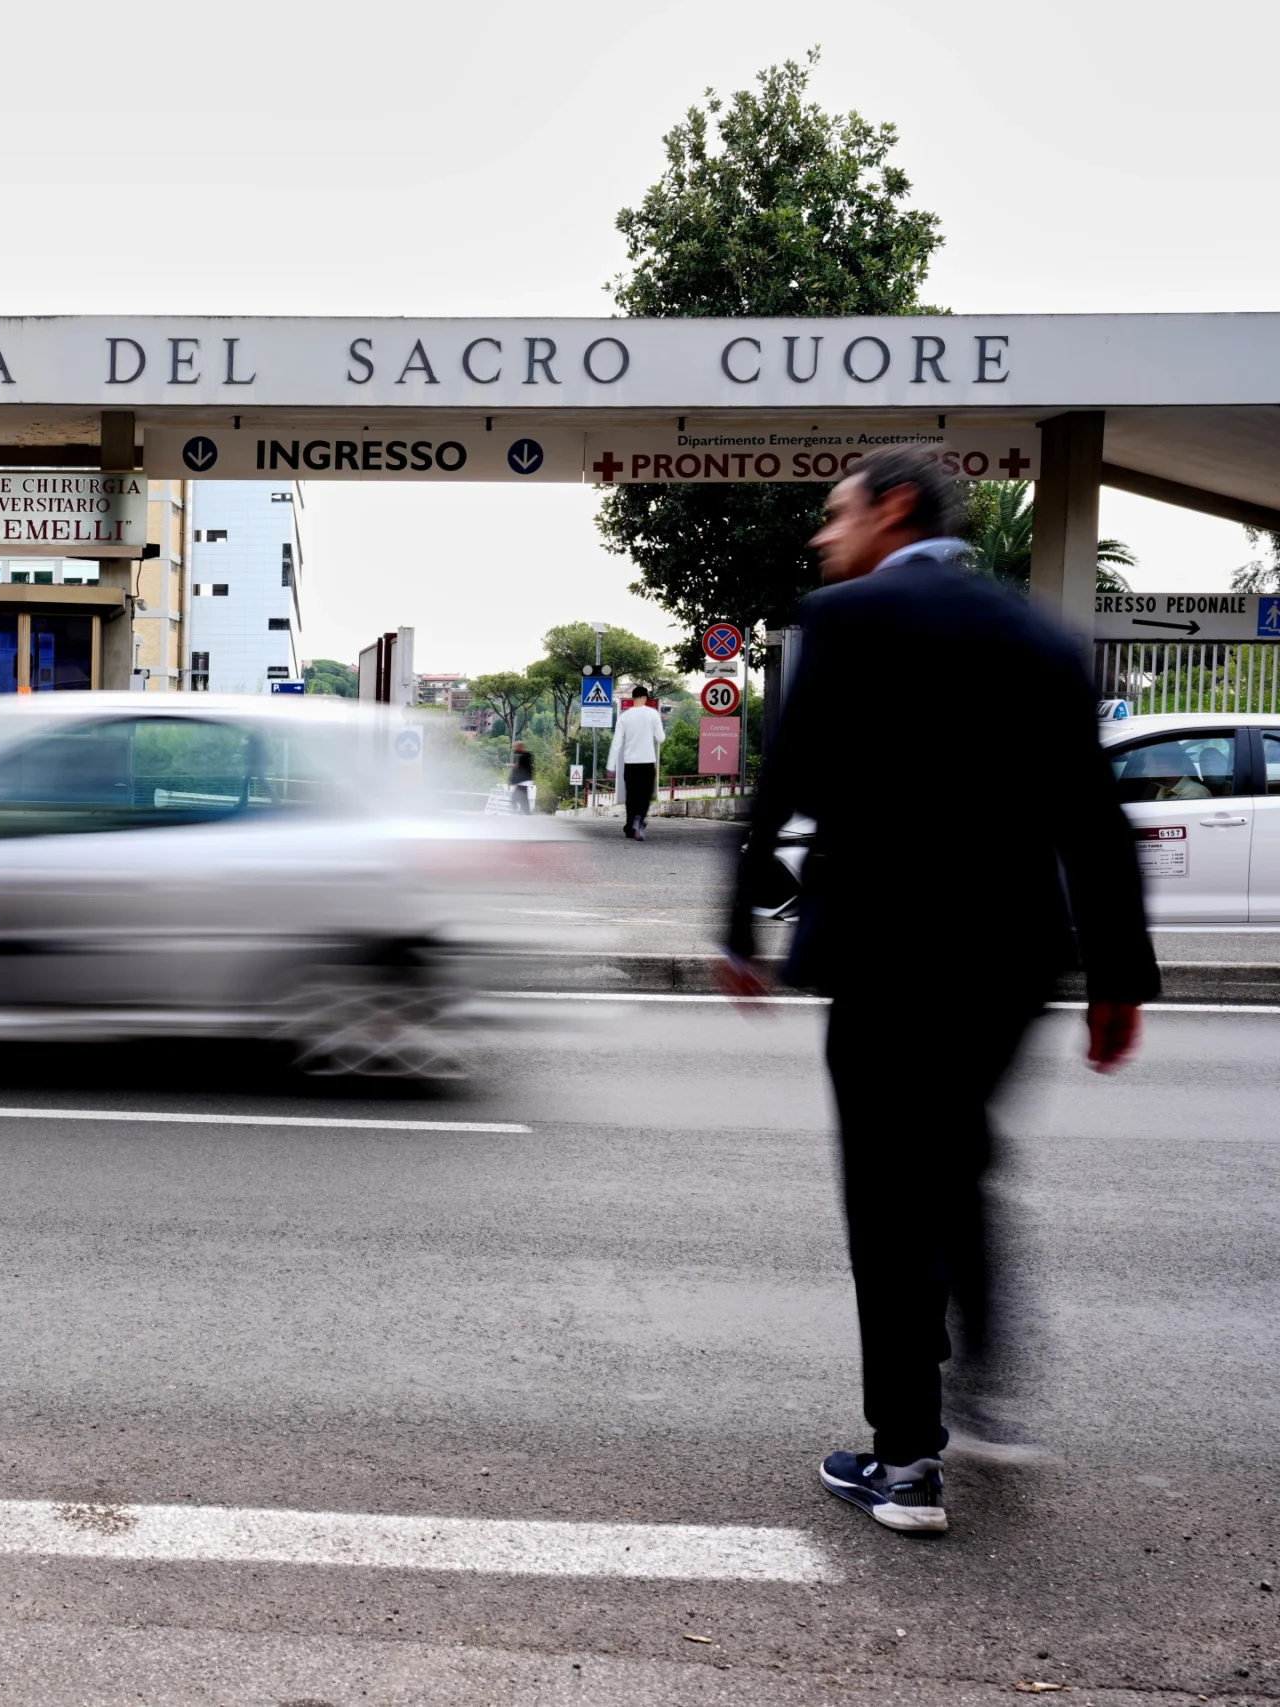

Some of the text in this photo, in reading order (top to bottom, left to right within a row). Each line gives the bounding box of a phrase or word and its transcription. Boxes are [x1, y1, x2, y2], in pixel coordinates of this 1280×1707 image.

[105, 337, 257, 385] DEL
[347, 337, 631, 385] SACRO
[721, 335, 1010, 384] CUORE
[678, 432, 944, 448] Dipartimento Emergenza e Accettazione
[256, 440, 467, 473] INGRESSO
[631, 452, 782, 479] PRONTO
[0, 478, 12, 493] E
[22, 478, 141, 495] CHIRURGIA
[1166, 596, 1246, 614] PEDONALE
[709, 688, 731, 706] 30
[1160, 829, 1181, 838] 6157
